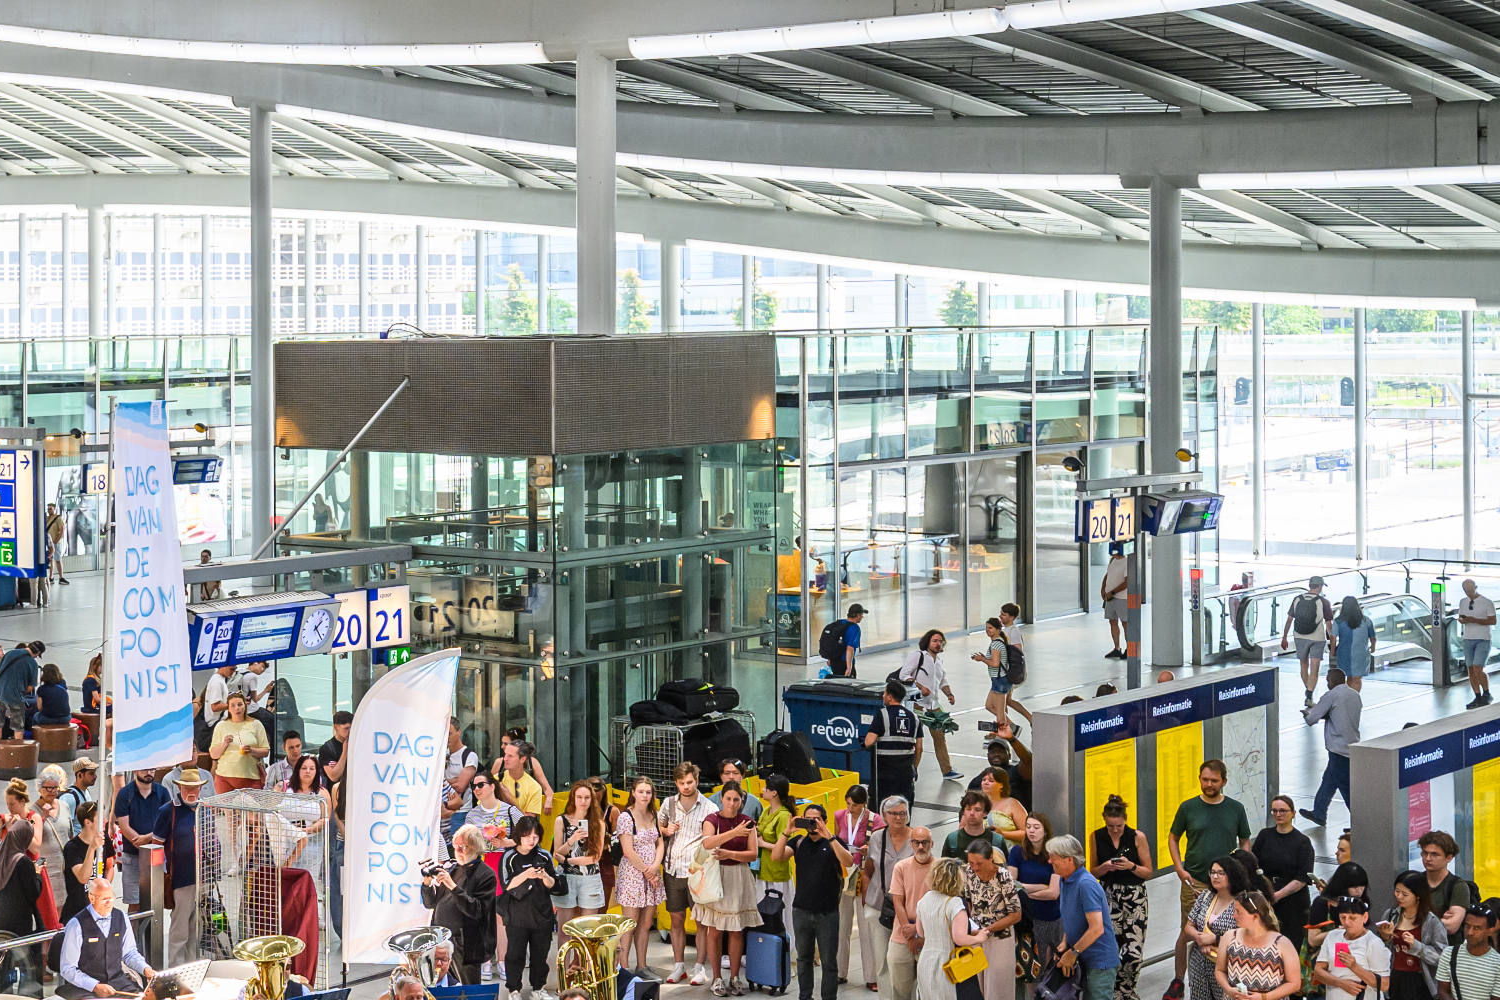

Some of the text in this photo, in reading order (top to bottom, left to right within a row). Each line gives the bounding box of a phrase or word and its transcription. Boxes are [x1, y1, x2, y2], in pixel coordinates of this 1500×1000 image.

[0, 463, 12, 477] 21
[91, 473, 106, 491] 18
[124, 465, 161, 497] DAG
[127, 506, 162, 537] VAN
[1091, 516, 1108, 539] 20
[1117, 513, 1131, 537] 21
[125, 546, 150, 578] DE
[122, 585, 177, 620] COM
[332, 613, 362, 648] 20
[375, 607, 403, 642] 21
[120, 626, 162, 659] PO
[124, 663, 181, 700] NIST
[1218, 682, 1256, 701] Reisinformatie
[1152, 697, 1193, 717] Reisinformatie
[811, 723, 859, 739] renewi
[1080, 713, 1124, 734] Reisinformatie
[373, 731, 434, 758] DAG
[1404, 746, 1444, 770] Reisinformatie
[373, 763, 430, 786] VAN
[371, 791, 410, 817] DE
[369, 821, 431, 846] COM
[368, 851, 409, 876] PO
